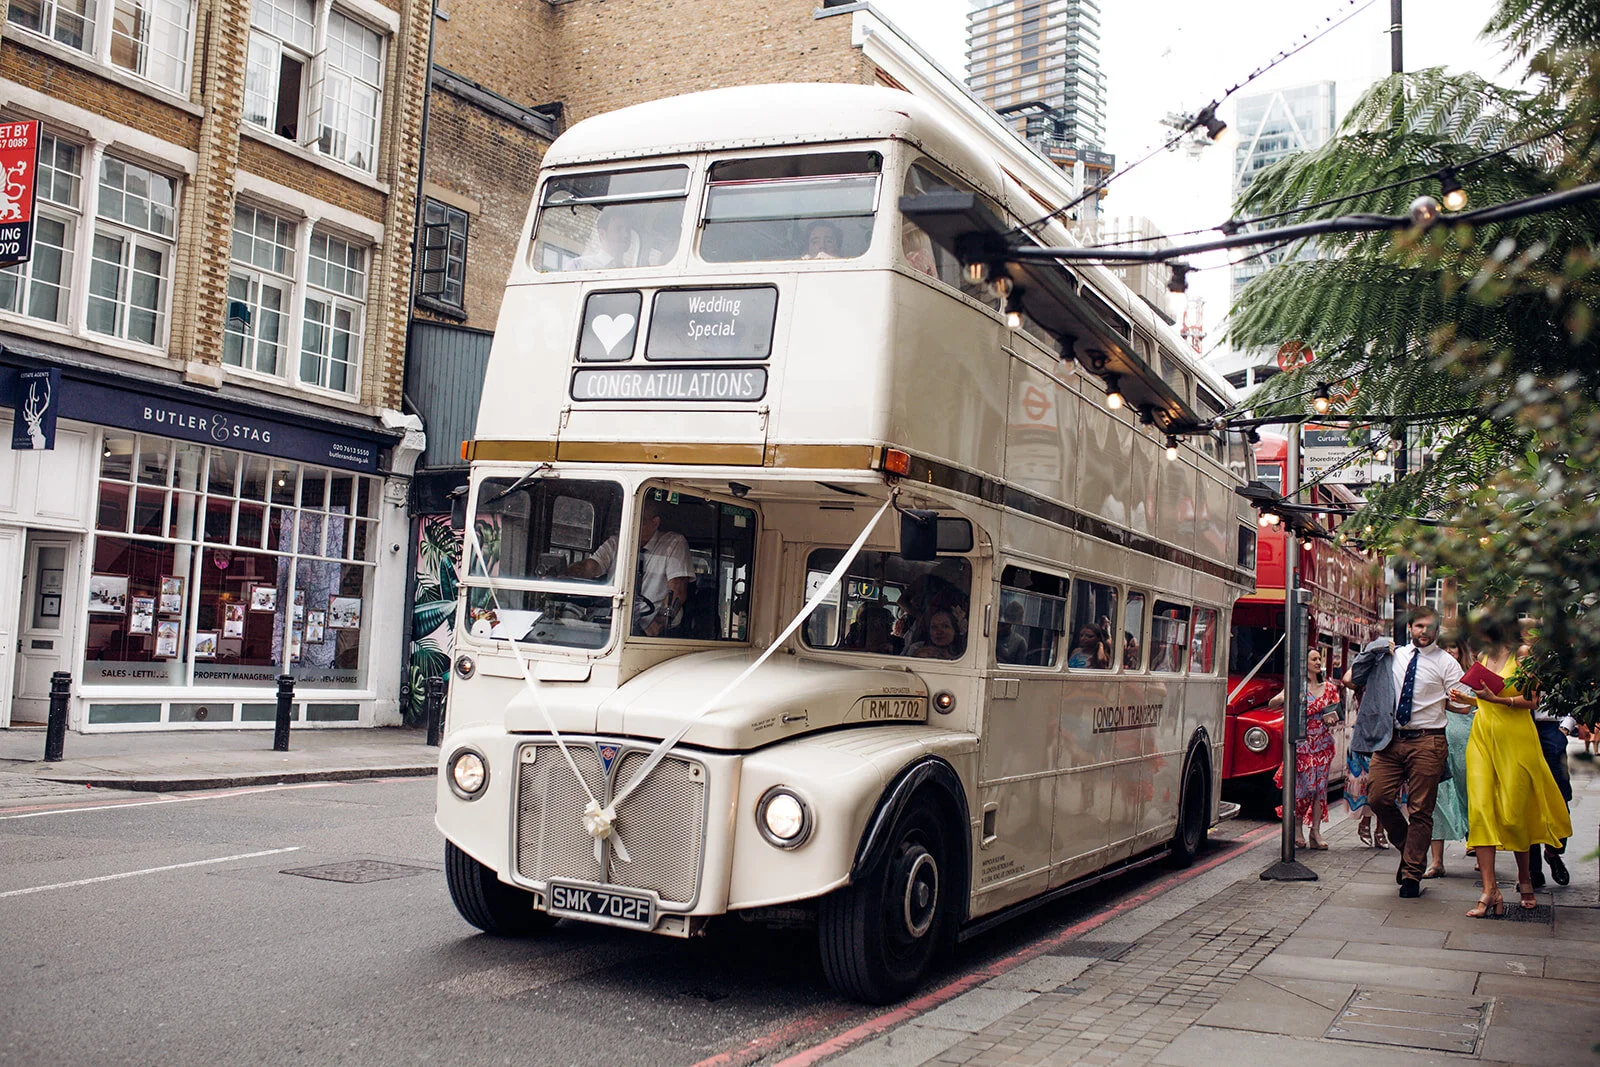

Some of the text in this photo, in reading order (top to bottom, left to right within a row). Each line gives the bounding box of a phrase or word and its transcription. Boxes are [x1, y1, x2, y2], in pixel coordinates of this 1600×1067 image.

[14, 124, 29, 137] BY
[8, 137, 28, 148] 0089
[1, 227, 21, 240] ING
[688, 296, 741, 316] Wedding
[687, 320, 736, 341] Special
[587, 372, 753, 398] CONGRATULATIONS
[143, 407, 271, 443] BUTLER & STAG
[332, 443, 344, 451] 020
[343, 446, 356, 454] 7613
[328, 450, 369, 465] butlerandstag.uk
[1309, 470, 1320, 478] 35
[101, 669, 127, 678] SALES
[193, 671, 231, 680] PROPERTY
[320, 675, 335, 683] NEW
[336, 676, 358, 684] HOMES
[869, 700, 920, 719] RML2702
[1093, 704, 1163, 734] LONDON TRANSPORT
[553, 887, 649, 920] SMK 702F
